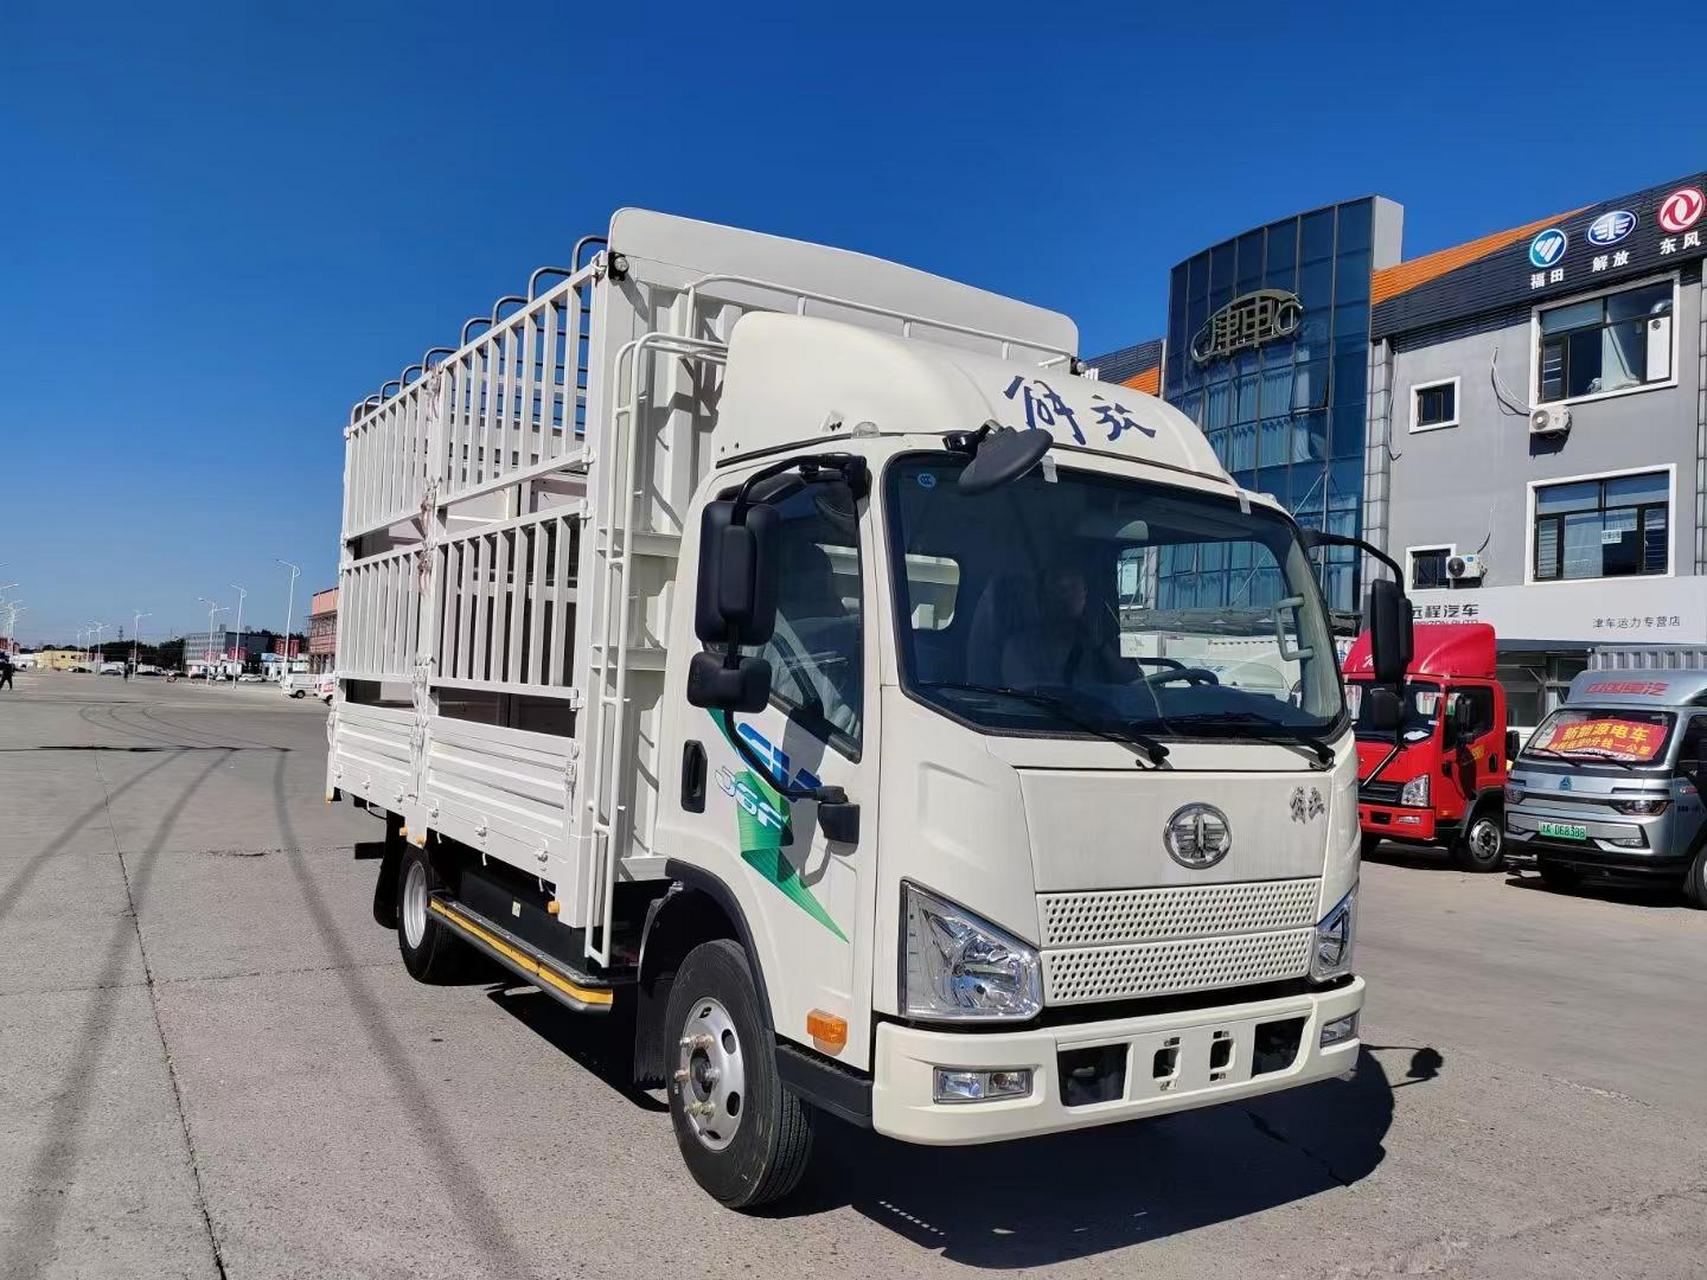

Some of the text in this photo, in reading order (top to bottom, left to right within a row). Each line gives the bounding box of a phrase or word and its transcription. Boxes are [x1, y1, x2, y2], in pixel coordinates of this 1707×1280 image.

[1659, 231, 1701, 255] 东风
[1592, 250, 1631, 273] 解放
[1530, 268, 1564, 290] 福田
[1563, 722, 1650, 743] 新能源电车
